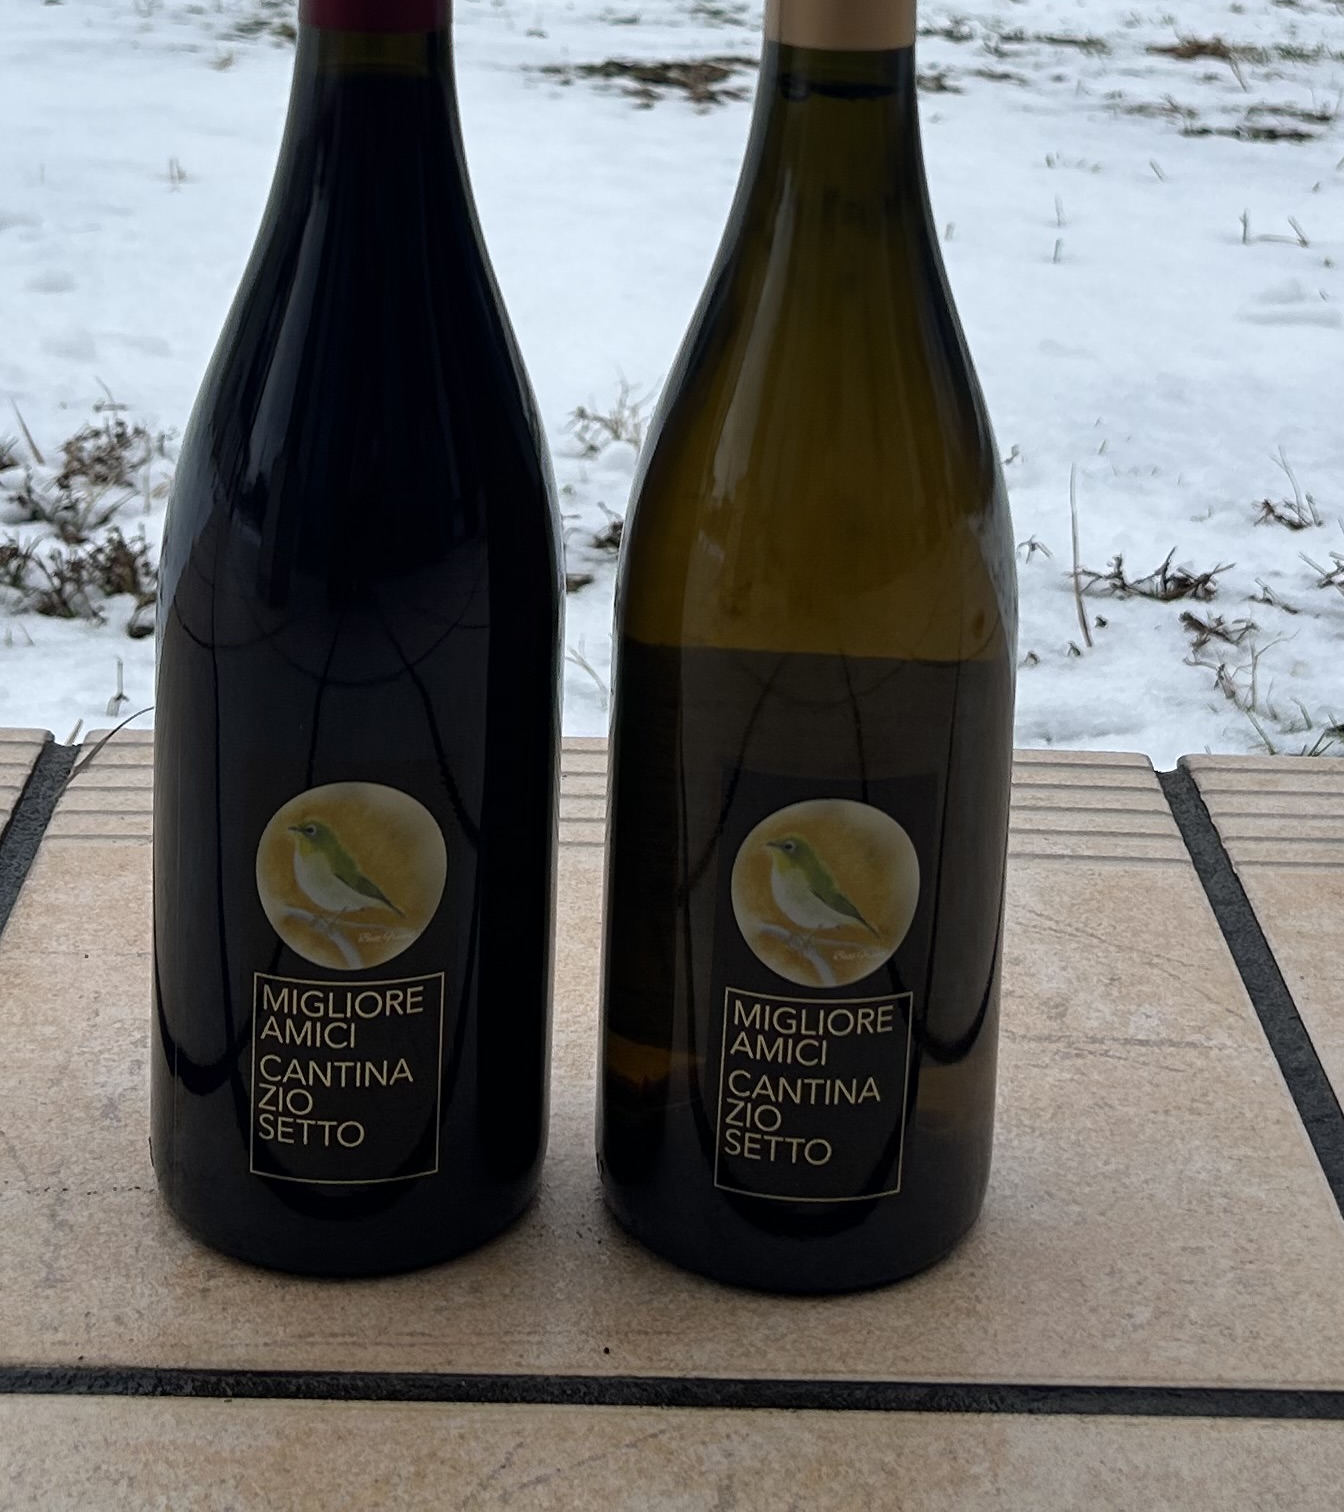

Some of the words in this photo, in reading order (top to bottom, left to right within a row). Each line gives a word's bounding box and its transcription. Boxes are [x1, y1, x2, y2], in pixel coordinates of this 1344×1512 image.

[264, 985, 424, 1018] MIGLIORE
[734, 1000, 893, 1036] MIGLIORE
[261, 1016, 355, 1049] AMICI
[731, 1032, 827, 1066] AMICI
[259, 1055, 414, 1088] CANTINA
[728, 1071, 881, 1105] CANTINA
[258, 1084, 313, 1115] ZIO
[725, 1099, 782, 1132] ZIO
[258, 1114, 365, 1147] SETTO
[725, 1129, 832, 1165] SETTO
